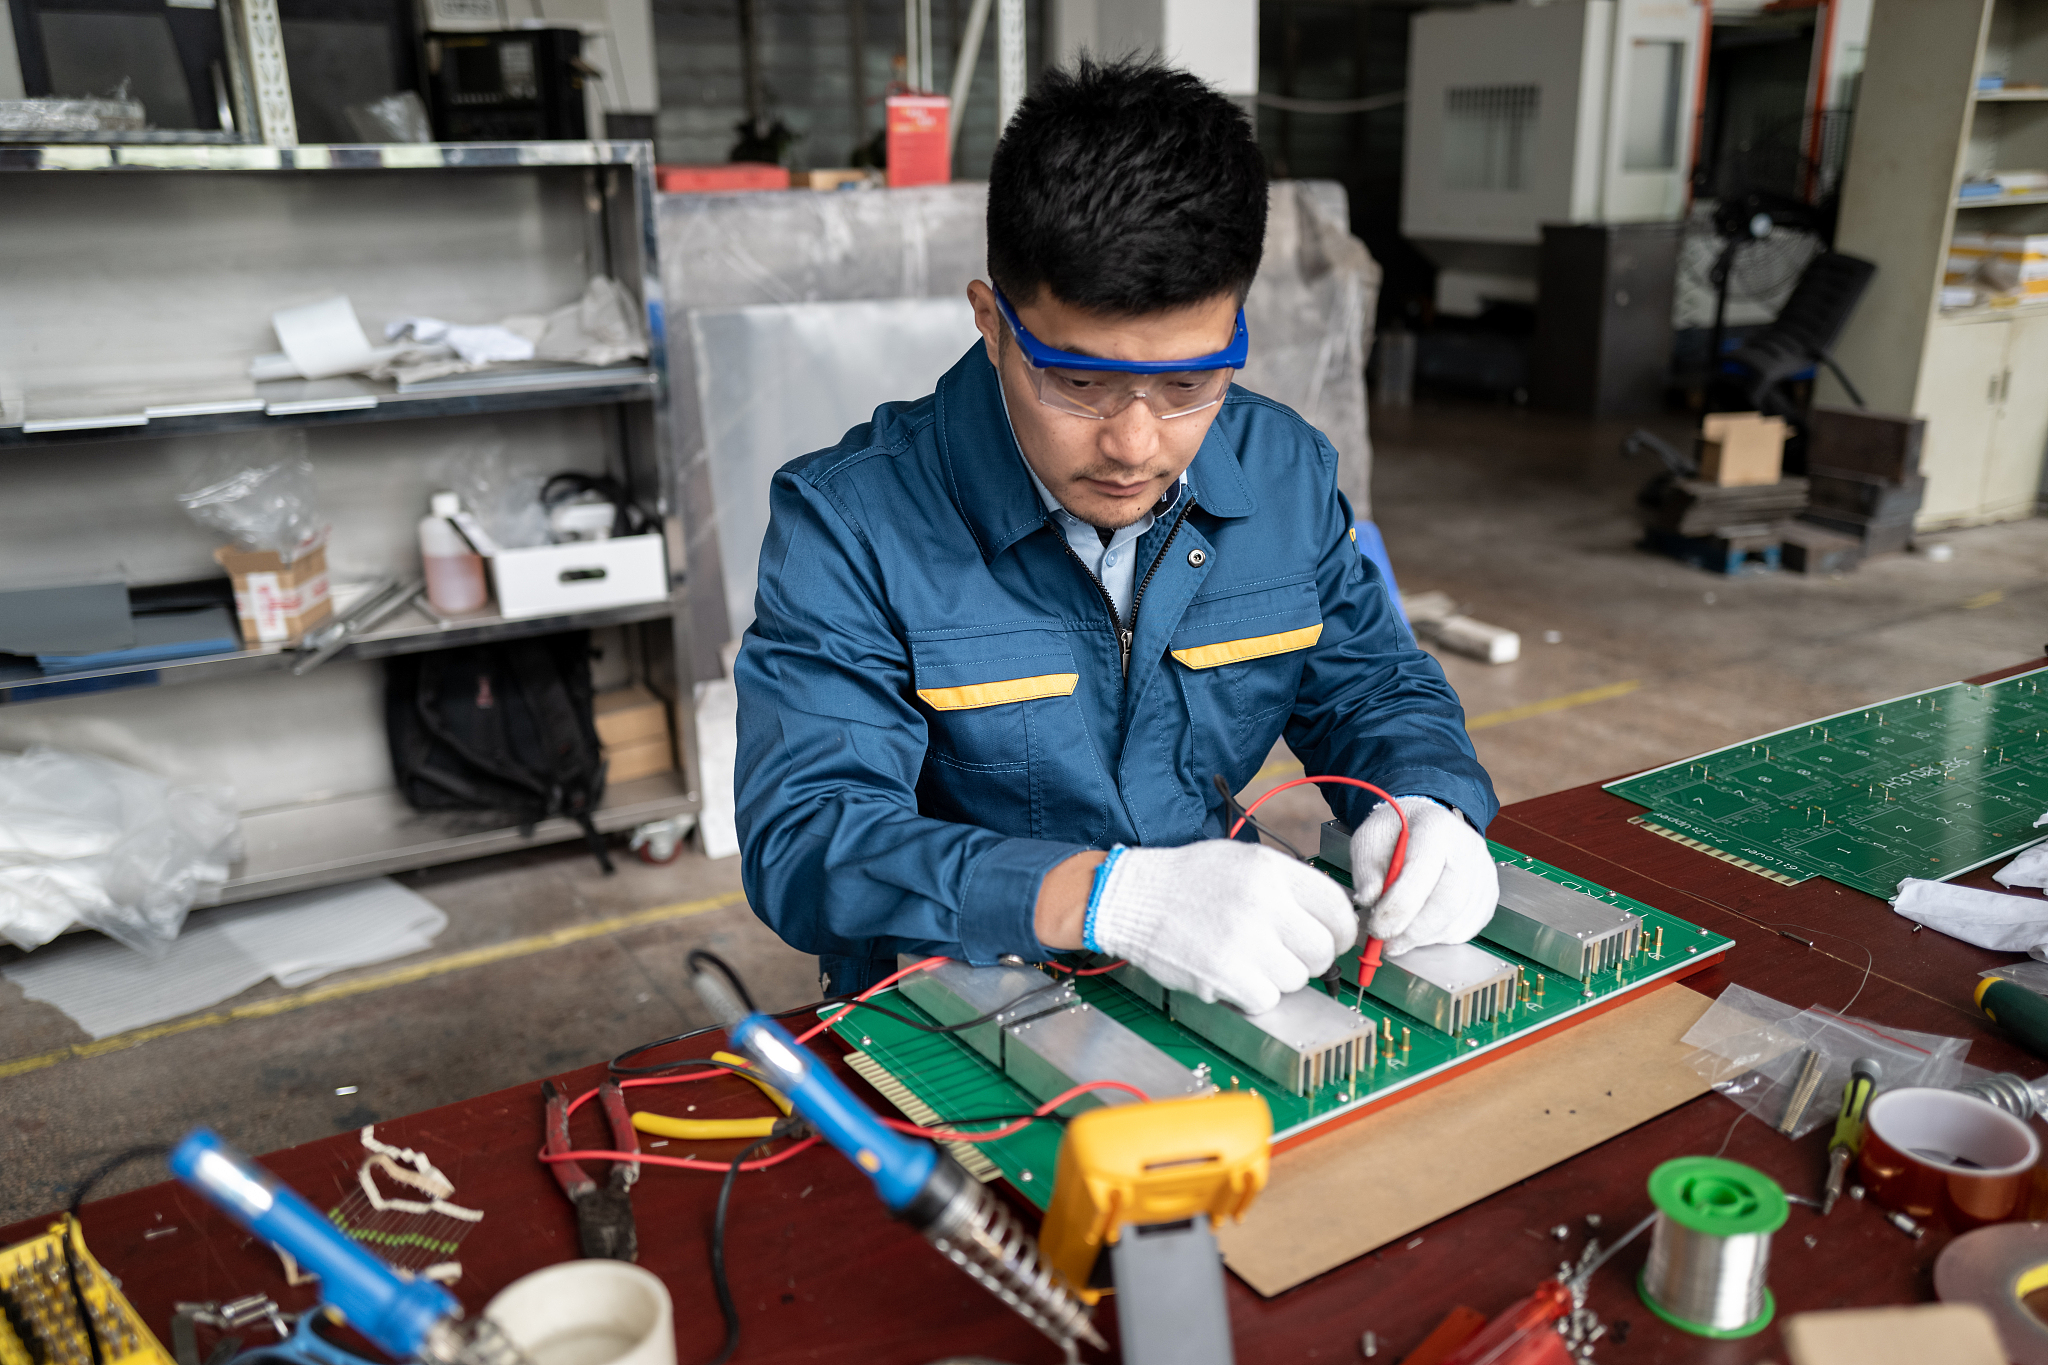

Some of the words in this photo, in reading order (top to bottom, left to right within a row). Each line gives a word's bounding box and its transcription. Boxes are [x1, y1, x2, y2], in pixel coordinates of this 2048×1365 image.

[1875, 736, 1895, 745] 10
[1797, 768, 1812, 776] 8
[1758, 775, 1773, 783] 8
[1733, 789, 1745, 797] 7
[1693, 797, 1705, 805] 7
[1936, 816, 1953, 825] 2
[1895, 825, 1912, 833] 2
[1525, 1002, 1545, 1013] A
